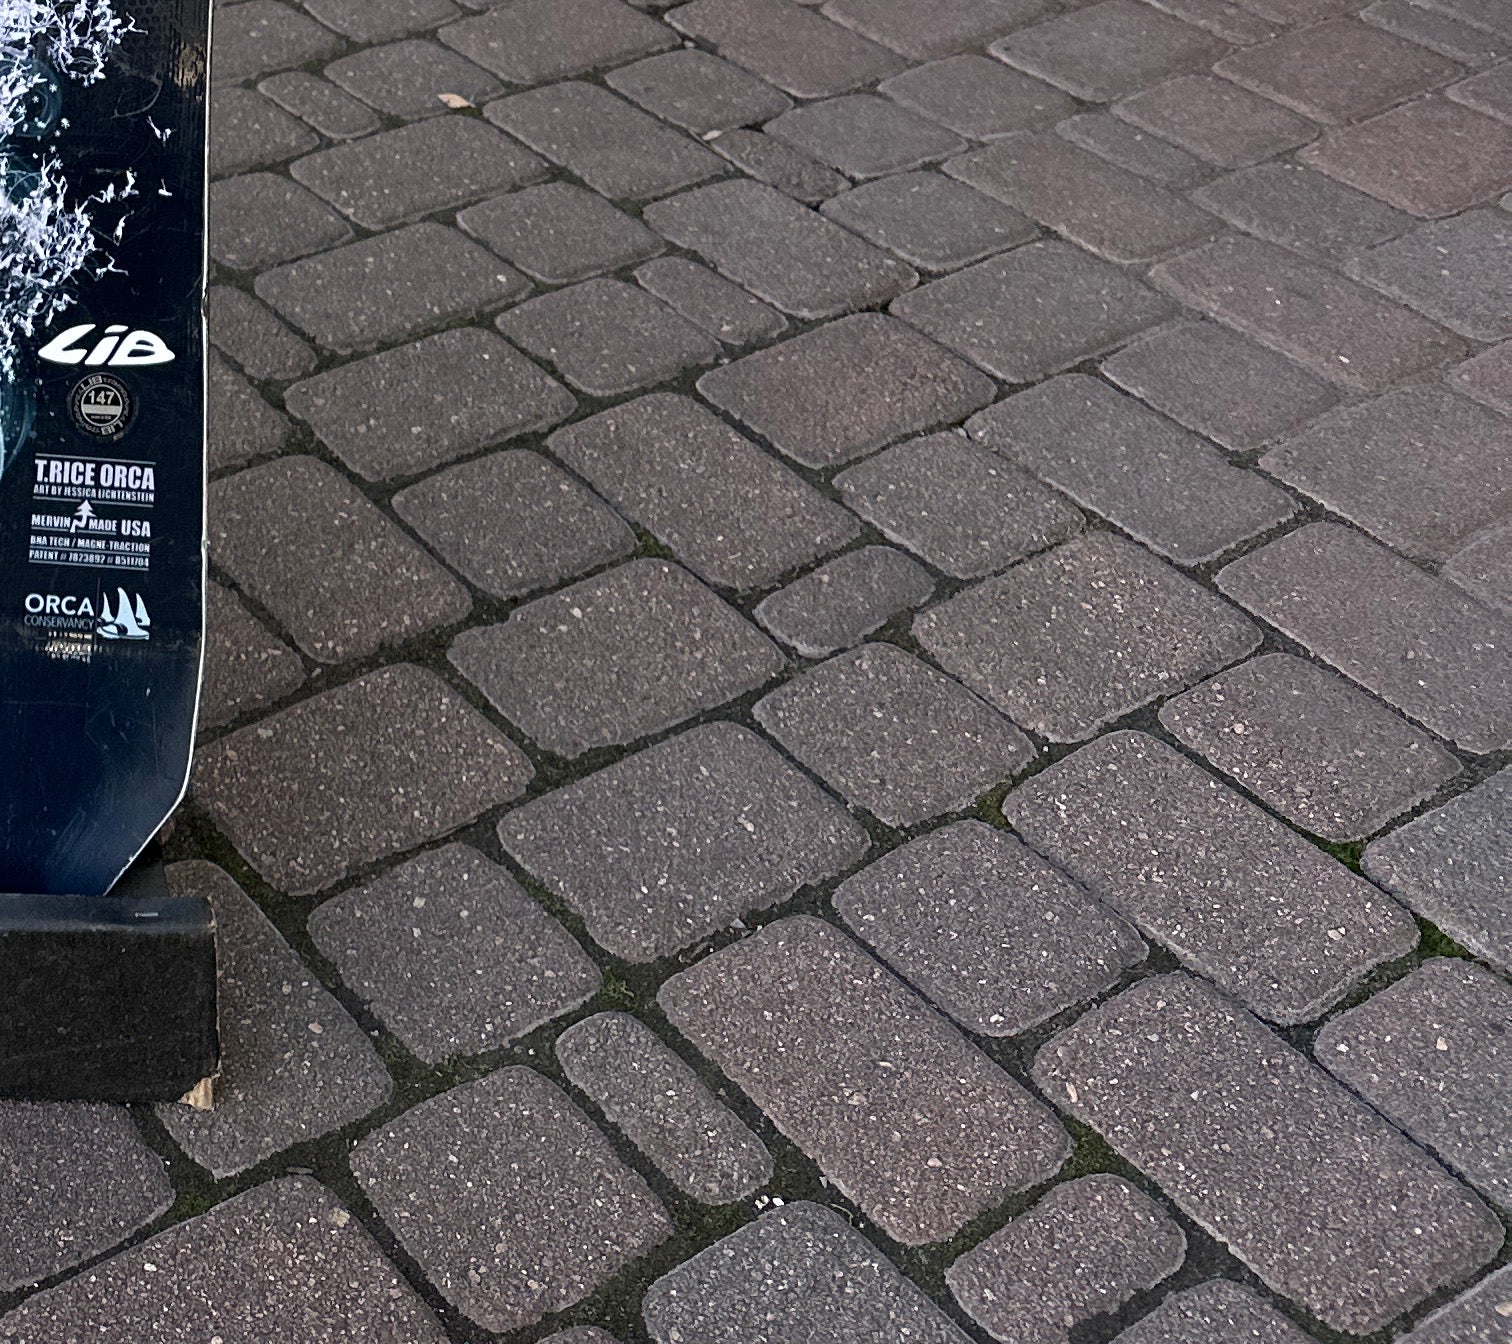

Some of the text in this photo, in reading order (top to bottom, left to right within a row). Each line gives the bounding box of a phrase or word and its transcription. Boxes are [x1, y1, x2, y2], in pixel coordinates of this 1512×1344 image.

[88, 390, 115, 406] 147
[34, 458, 156, 491] T.RICE ORCA
[33, 484, 155, 503] ART BY JESSICA LICHTENSTEIN
[31, 514, 152, 538] MERVIN MADE USA
[49, 536, 70, 548] TECH
[29, 549, 59, 560] PATENT
[24, 592, 95, 617] ORCA
[23, 614, 95, 631] CONSERVANCY
